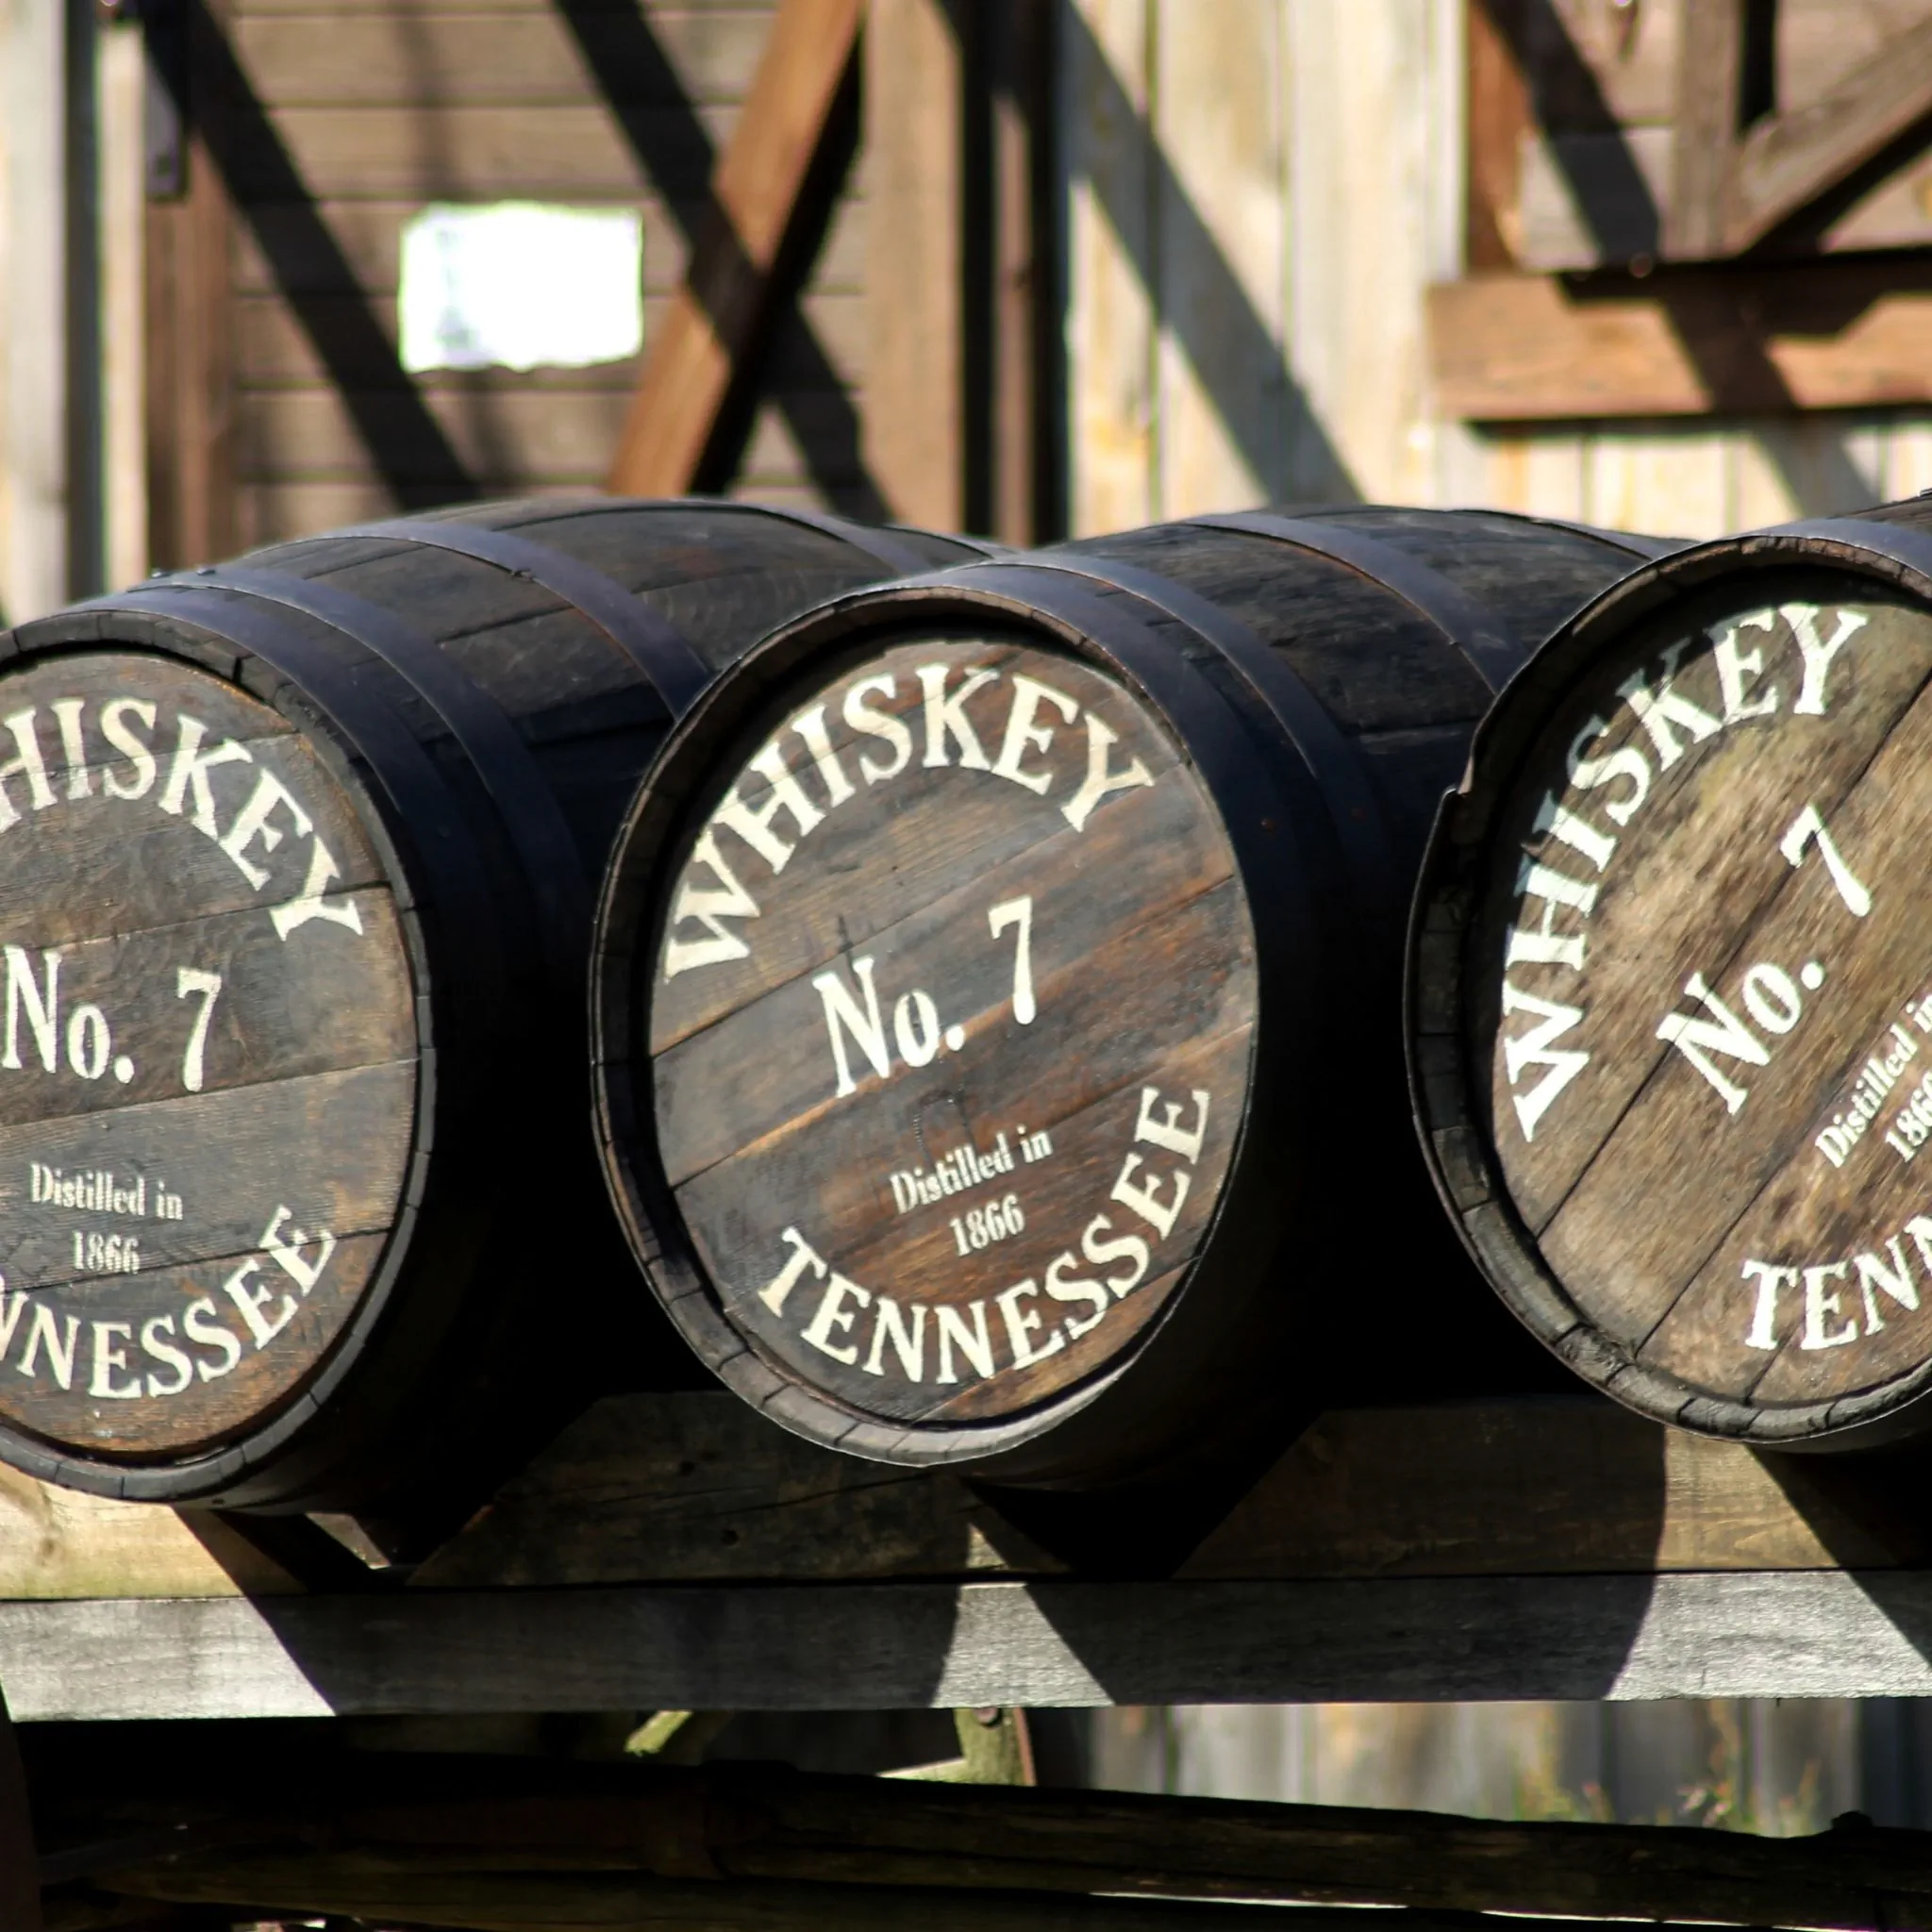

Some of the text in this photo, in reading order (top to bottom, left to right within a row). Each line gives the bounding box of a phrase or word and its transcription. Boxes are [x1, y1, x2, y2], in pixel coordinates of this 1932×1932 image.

[663, 662, 1155, 985] WHISKEY
[1503, 602, 1869, 1143] WHISKEY
[1, 944, 222, 1092] No. 7
[812, 894, 1036, 1099] No. 7
[1657, 804, 1872, 1116] No. 7
[890, 1123, 1054, 1215] Distilled in
[1815, 1023, 1919, 1169] Distilled
[30, 1160, 184, 1221] Distilled in
[72, 1229, 141, 1274] 1866
[758, 1086, 1211, 1385] TENNESSEE
[949, 1191, 1025, 1257] 1866
